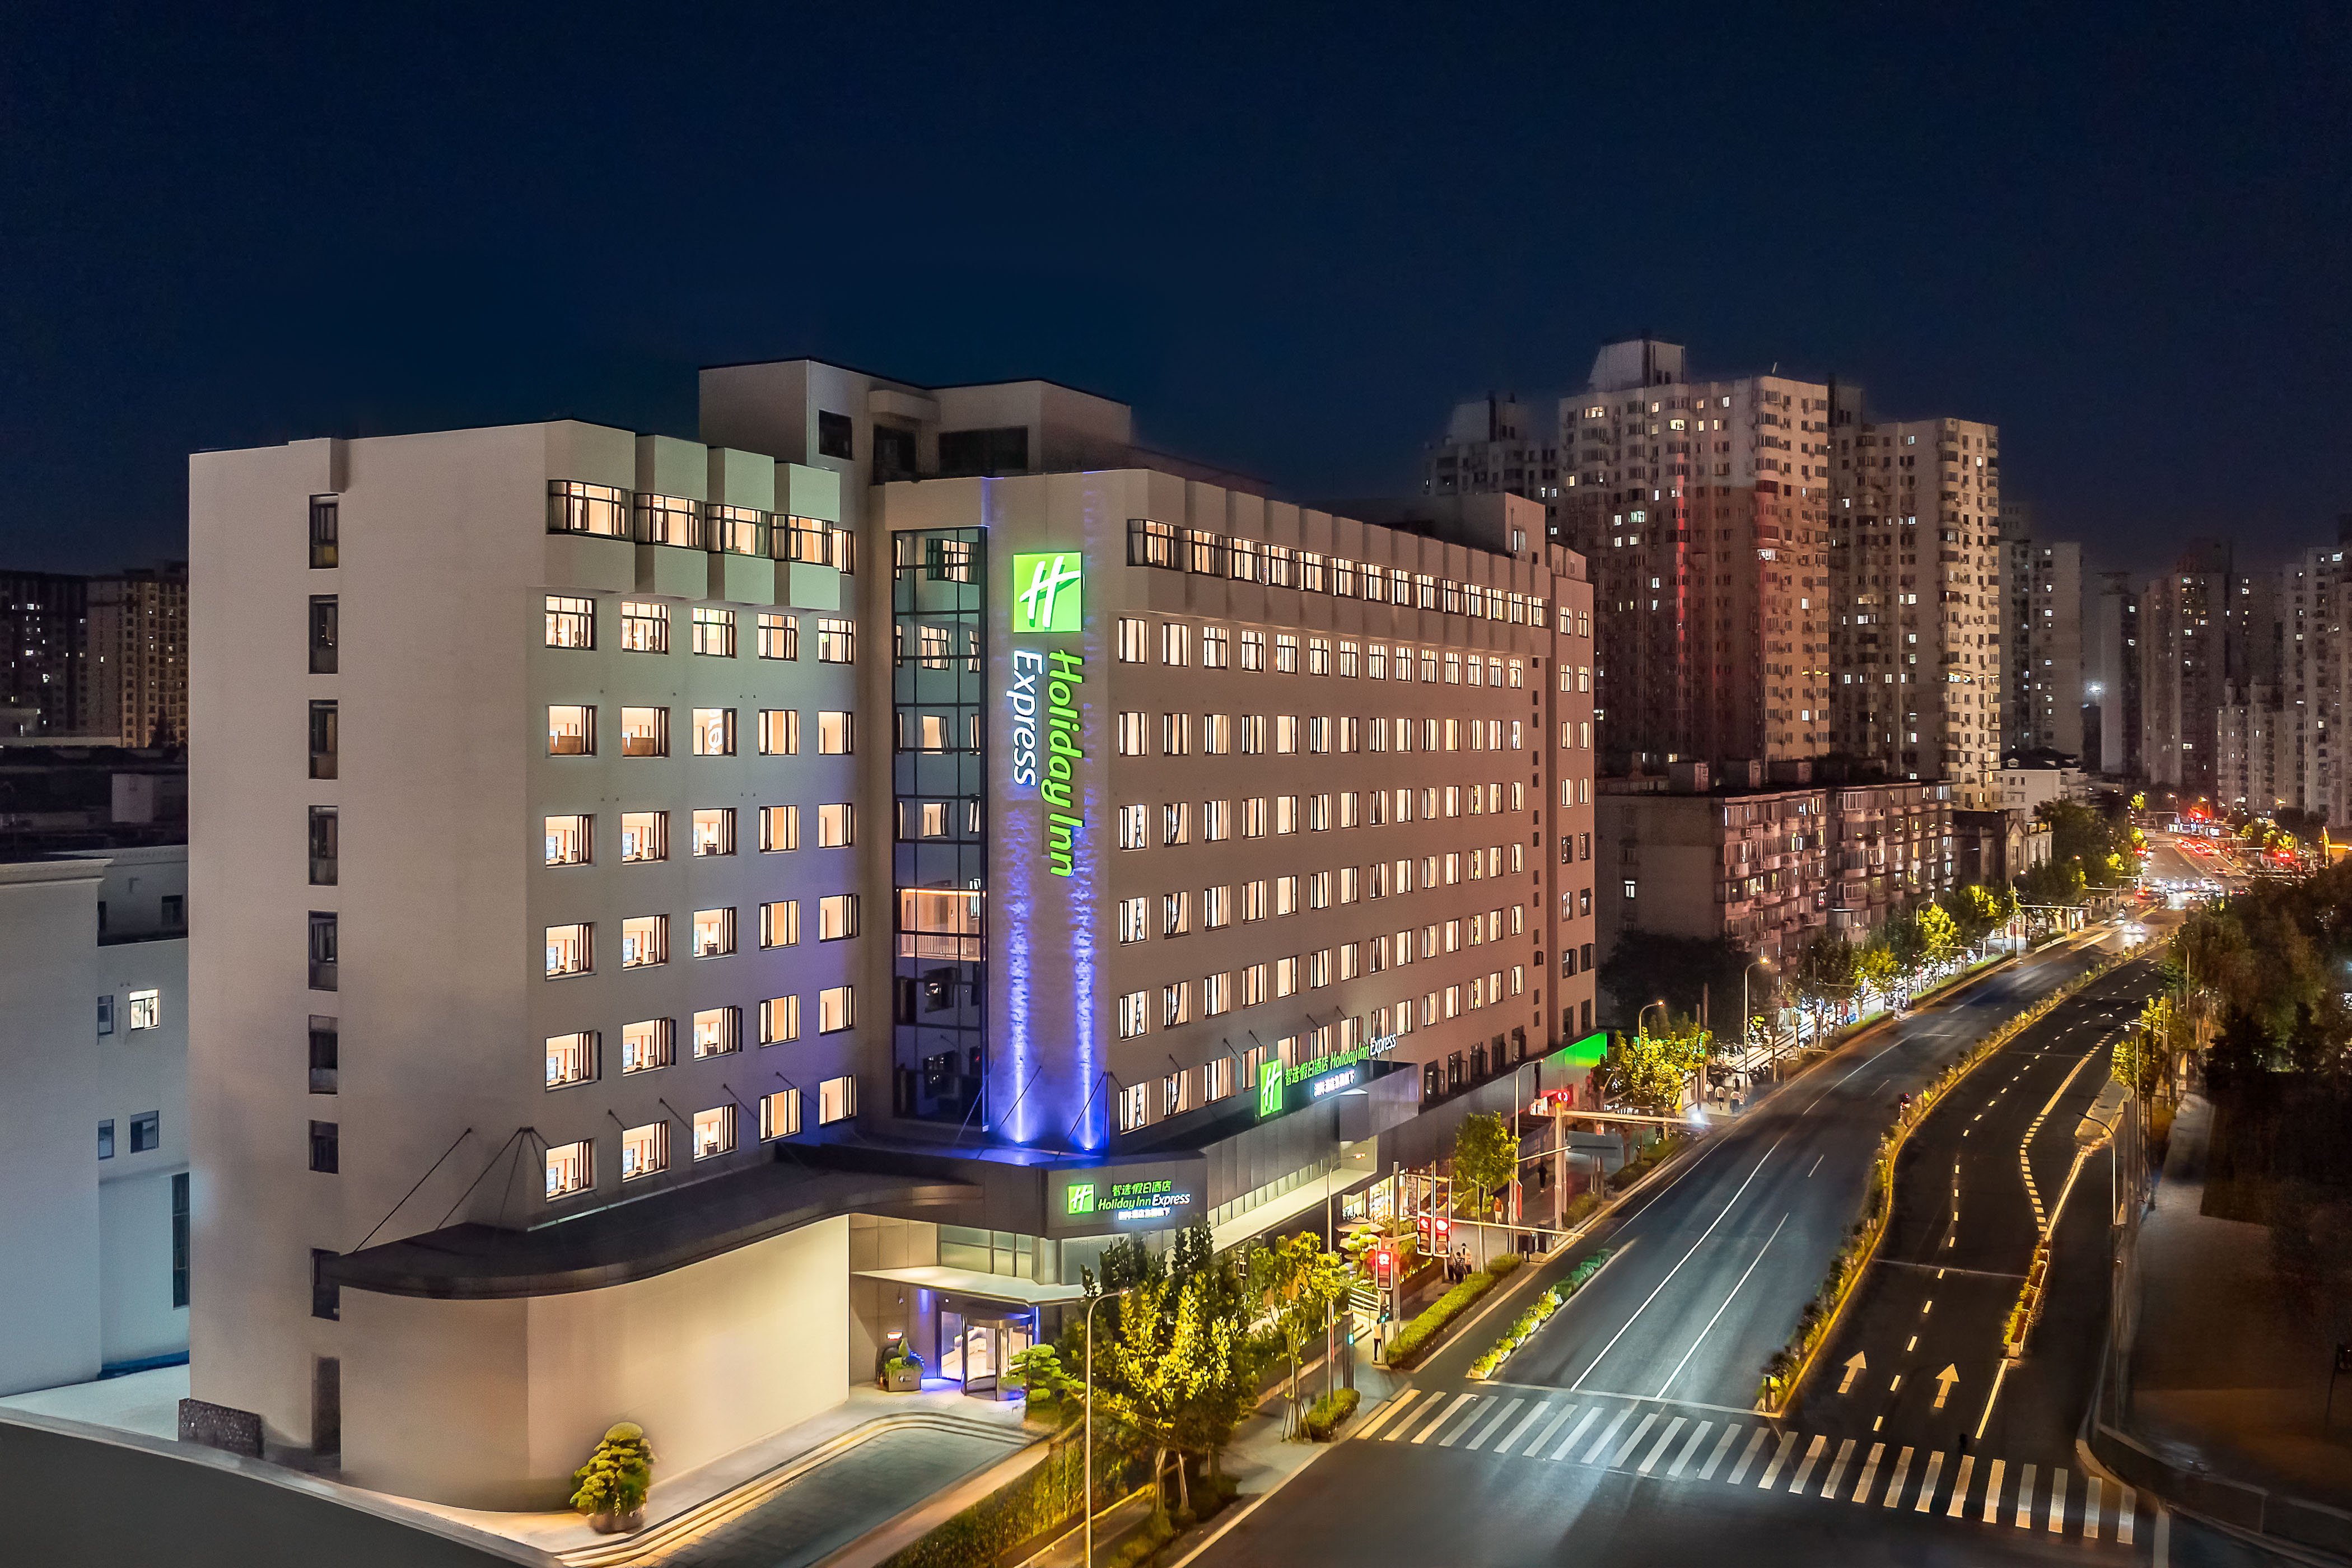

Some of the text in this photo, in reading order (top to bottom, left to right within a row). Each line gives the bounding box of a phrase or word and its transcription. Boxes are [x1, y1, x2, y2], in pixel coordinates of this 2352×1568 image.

[1006, 650, 1043, 786] Express
[1040, 650, 1085, 877] Holiday Inn
[1285, 1056, 1328, 1086] 智选假日酒店
[1330, 1047, 1357, 1070] Holiday
[1358, 1042, 1369, 1060] Inn
[1370, 1034, 1397, 1058] Express
[1098, 1194, 1191, 1210] Holiday Inn Express
[1112, 1180, 1172, 1196] 智选假日酒店
